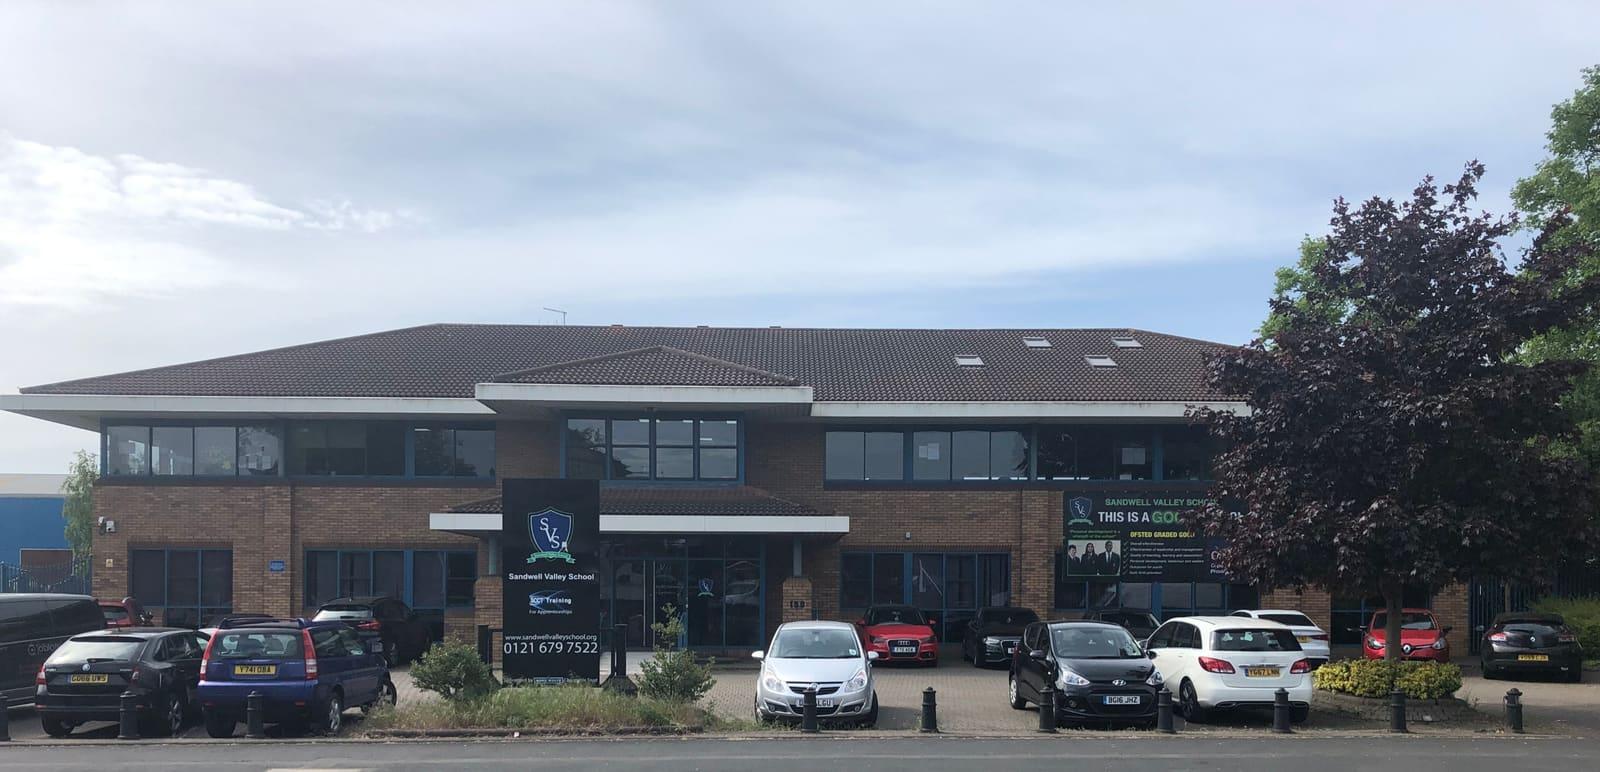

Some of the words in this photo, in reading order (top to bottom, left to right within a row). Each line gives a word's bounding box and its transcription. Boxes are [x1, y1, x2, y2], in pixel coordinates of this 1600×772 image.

[1105, 498, 1150, 506] SANDWELL
[1152, 498, 1184, 506] VALLEY
[1186, 498, 1217, 506] SCHO
[1098, 511, 1124, 522] THIS
[1127, 511, 1139, 522] IS
[1141, 511, 1150, 522] A
[1152, 511, 1180, 524] GO
[544, 573, 567, 582] Valley
[546, 597, 572, 606] Training
[504, 642, 534, 654] 0121
[539, 642, 564, 654] 679
[566, 642, 598, 654] 7522
